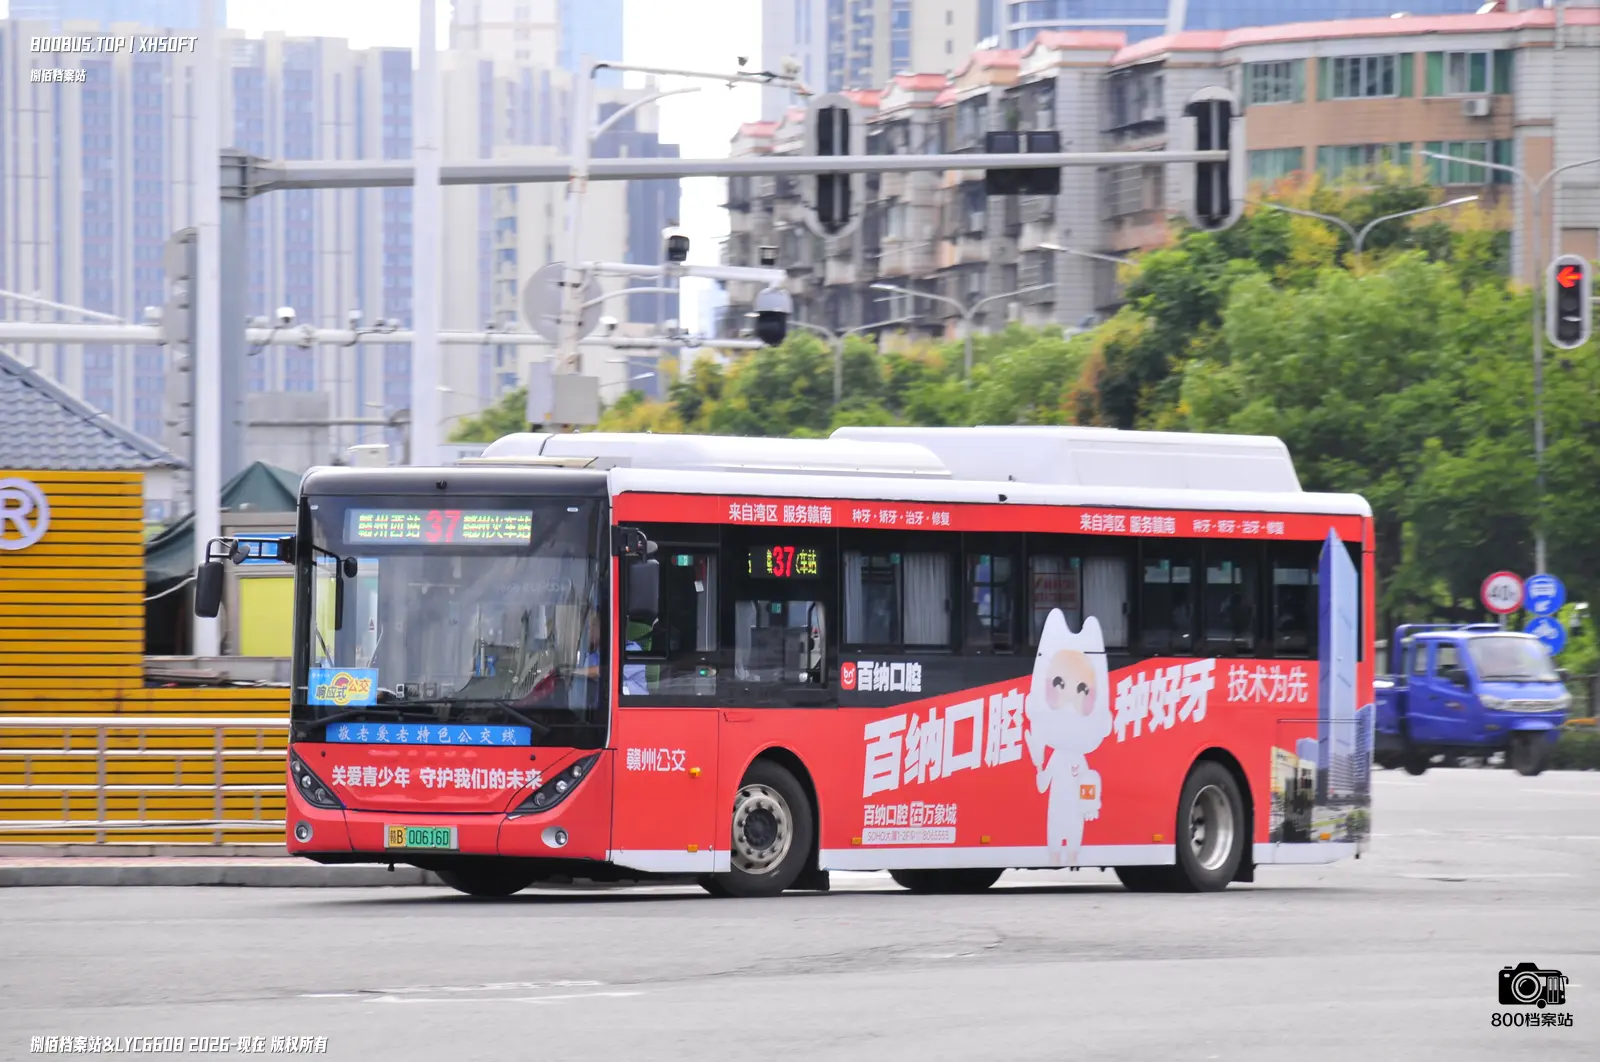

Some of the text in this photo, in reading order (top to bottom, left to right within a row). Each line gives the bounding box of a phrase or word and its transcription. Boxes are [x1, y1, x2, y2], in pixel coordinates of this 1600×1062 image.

[729, 502, 832, 524] 来自湾区 服务赣南
[1080, 513, 1176, 534] 来自湾区 服务赣南
[425, 510, 461, 543] 37
[773, 546, 795, 577] 37
[857, 661, 922, 692] 百纳口腔
[1227, 664, 1309, 703] 技术为先
[1114, 658, 1217, 743] 种好牙
[338, 725, 518, 746] 敬老爱老特色公交线
[862, 688, 1025, 799] 百纳口腔
[626, 747, 686, 773] 赣州公交
[331, 766, 543, 791] 关爱青少年 守护我们的未来
[863, 802, 957, 826] 百纳口腔 在万象城
[408, 829, 449, 846] 00616D
